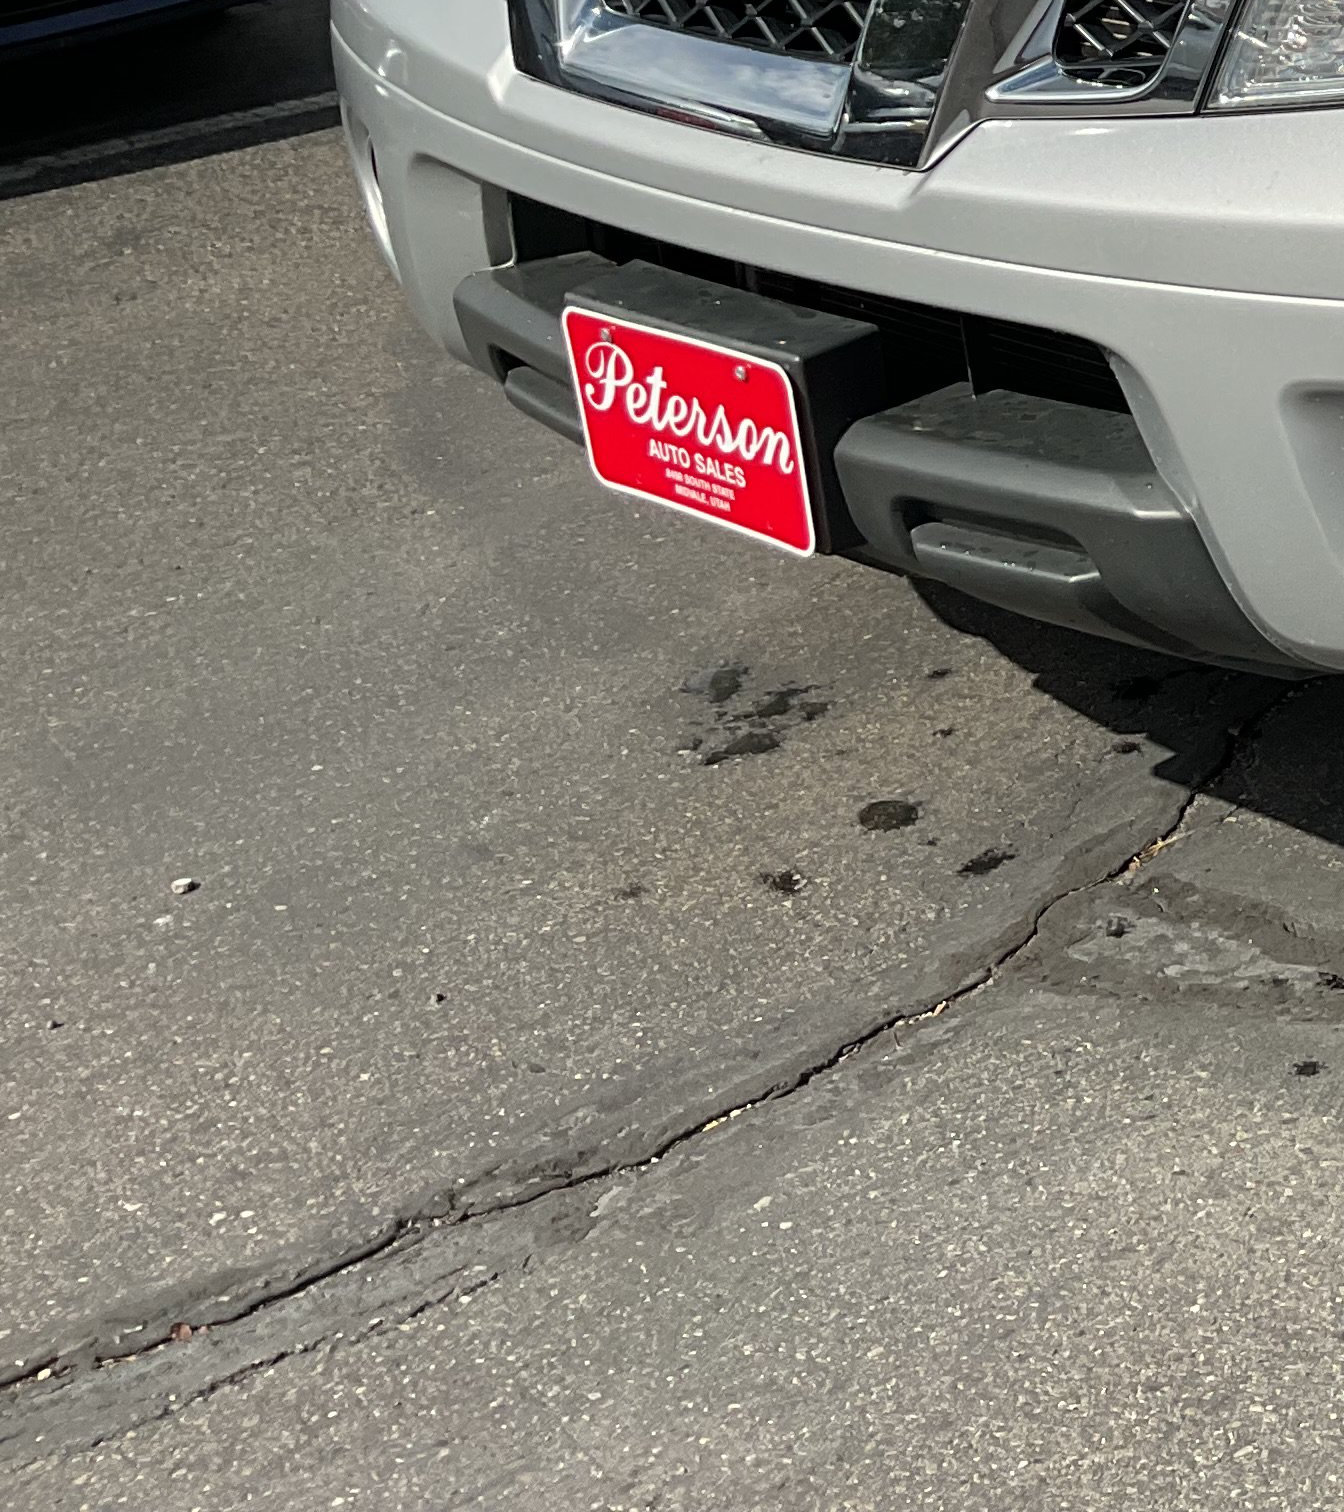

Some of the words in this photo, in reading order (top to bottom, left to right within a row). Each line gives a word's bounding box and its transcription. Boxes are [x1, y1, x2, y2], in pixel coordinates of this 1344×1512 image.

[585, 341, 795, 474] Peterson
[649, 438, 691, 469] AUTO
[694, 453, 746, 487] SALES
[684, 474, 711, 492] SOUTH
[711, 483, 735, 500] STATE
[709, 495, 731, 512] UTAH
